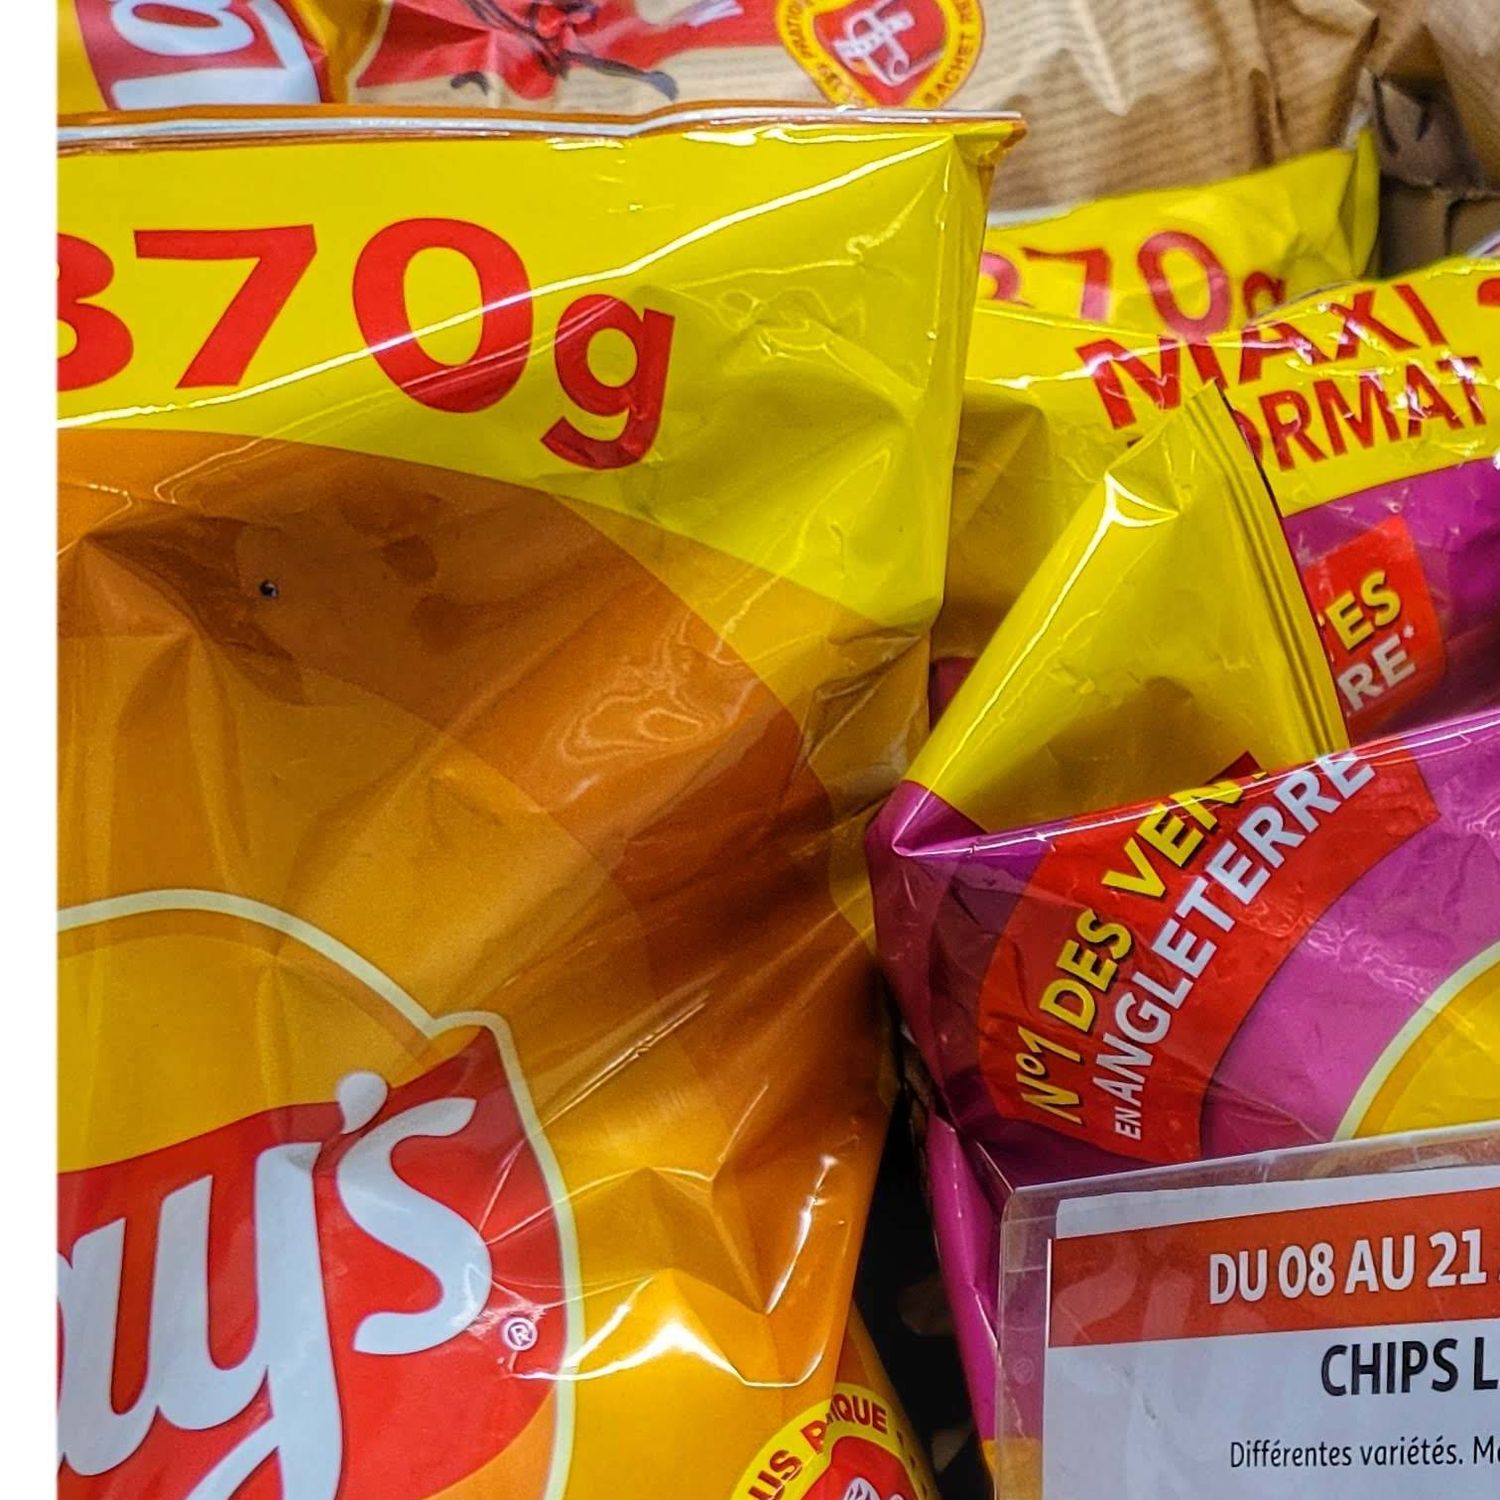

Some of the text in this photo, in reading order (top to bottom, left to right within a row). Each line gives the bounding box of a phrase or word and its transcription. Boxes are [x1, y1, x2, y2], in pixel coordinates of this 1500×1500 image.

[1038, 907, 1134, 1034] DES
[1090, 750, 1378, 1142] EN ANGLETERRE
[1208, 1248, 1270, 1305] DU
[1276, 1241, 1336, 1299] 08
[1343, 1232, 1417, 1295] AU
[1427, 1227, 1488, 1288] 21
[1319, 1336, 1460, 1398] CHIPS
[1229, 1438, 1353, 1470] Différentes
[1360, 1432, 1465, 1468] variétés.
